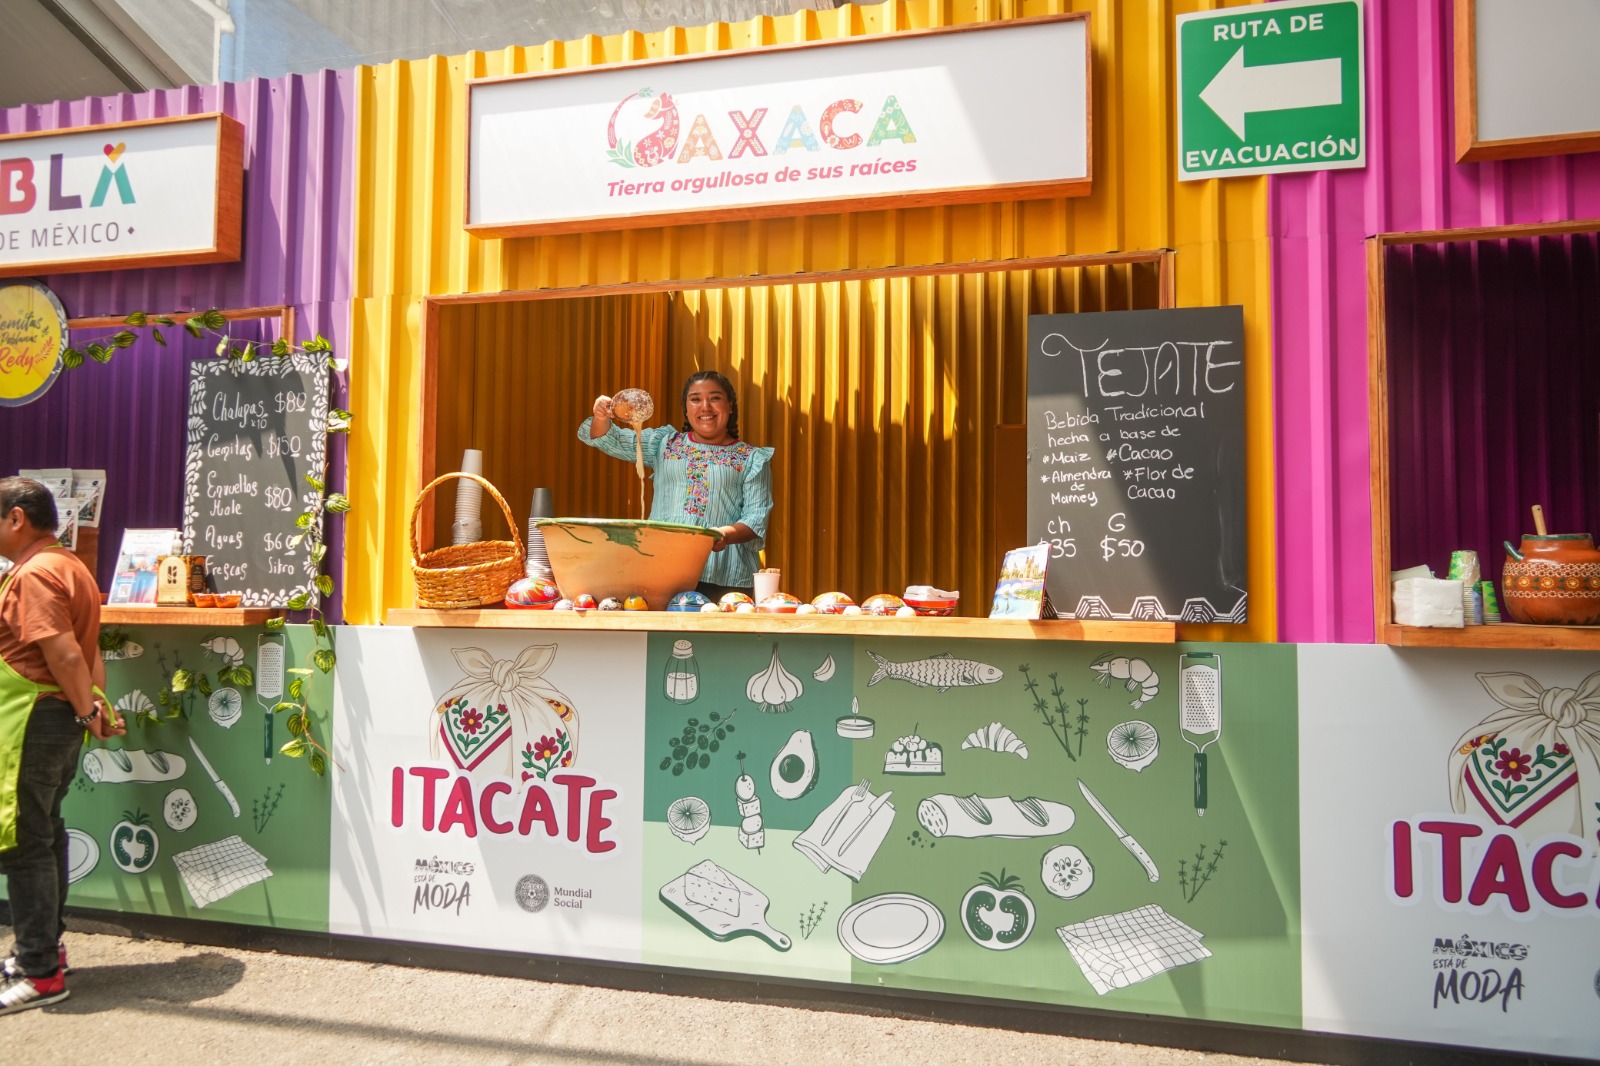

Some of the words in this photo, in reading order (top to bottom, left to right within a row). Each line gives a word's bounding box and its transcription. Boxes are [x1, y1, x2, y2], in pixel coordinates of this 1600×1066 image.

[1213, 18, 1281, 41] RUTA
[1290, 13, 1324, 33] DE
[606, 87, 917, 169] OAXACA
[1186, 135, 1357, 168] EVACUACIÓN
[607, 179, 665, 197] Tierra
[671, 168, 768, 194] orgullosa
[774, 166, 802, 183] de
[807, 162, 844, 180] sus
[849, 158, 917, 177] raíces
[31, 222, 120, 248] MÉXICO
[0, 311, 43, 332] emitas
[1041, 333, 1241, 397] TEJATE
[212, 391, 264, 429] Chalupas
[274, 390, 307, 413] $80
[1044, 406, 1100, 430] Bebida
[1104, 402, 1205, 423] Tradicional
[267, 433, 301, 458] $150
[1047, 432, 1090, 448] hecha
[1099, 431, 1111, 441] a
[1119, 429, 1157, 440] base
[1161, 425, 1181, 437] de
[1172, 463, 1195, 479] de
[264, 485, 292, 509] $80
[1051, 491, 1098, 507] Mamey
[1127, 485, 1176, 500] Cacao
[1070, 482, 1086, 491] de
[210, 499, 243, 517] Mole
[1107, 512, 1126, 532] G
[205, 524, 243, 550] Aguas
[1100, 535, 1145, 562] $50
[205, 554, 248, 581] Frescas
[391, 766, 618, 853] ITACATE
[414, 855, 475, 876] MÉXICO
[1392, 820, 1600, 913] ITAC
[413, 881, 471, 916] MODA
[553, 887, 592, 899] Mundial
[553, 898, 583, 909] Social
[1432, 933, 1528, 961] MÉXICO
[1455, 958, 1468, 969] DE
[1433, 967, 1526, 1013] MODA
